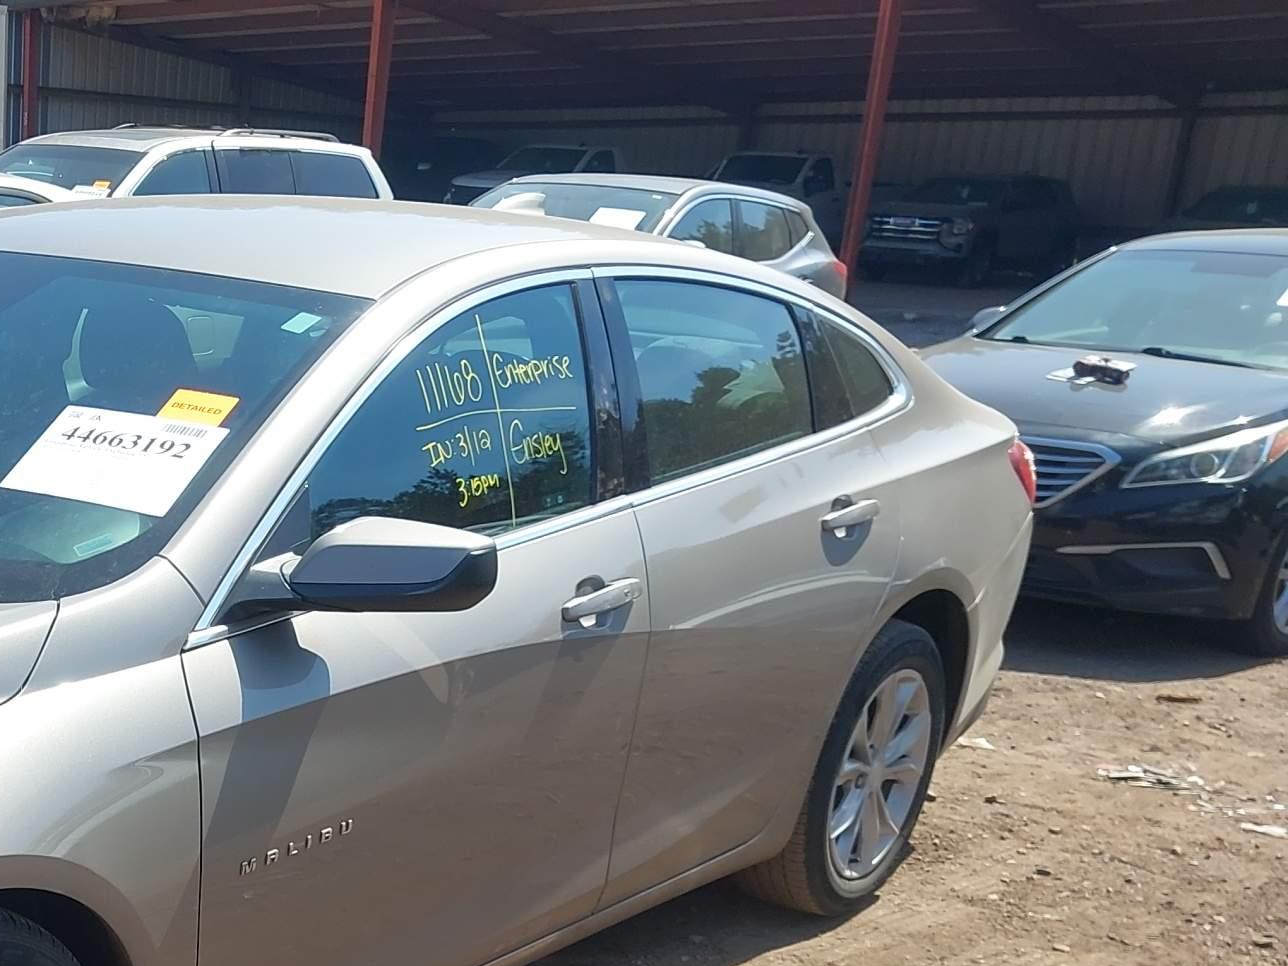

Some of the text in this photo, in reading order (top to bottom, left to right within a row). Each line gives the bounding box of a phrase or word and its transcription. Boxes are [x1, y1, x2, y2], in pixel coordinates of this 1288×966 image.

[415, 359, 483, 414] 11168
[492, 352, 574, 389] Enterprise
[170, 401, 223, 416] DETAILED
[61, 426, 193, 459] 44663192
[240, 819, 354, 876] MALIBU
